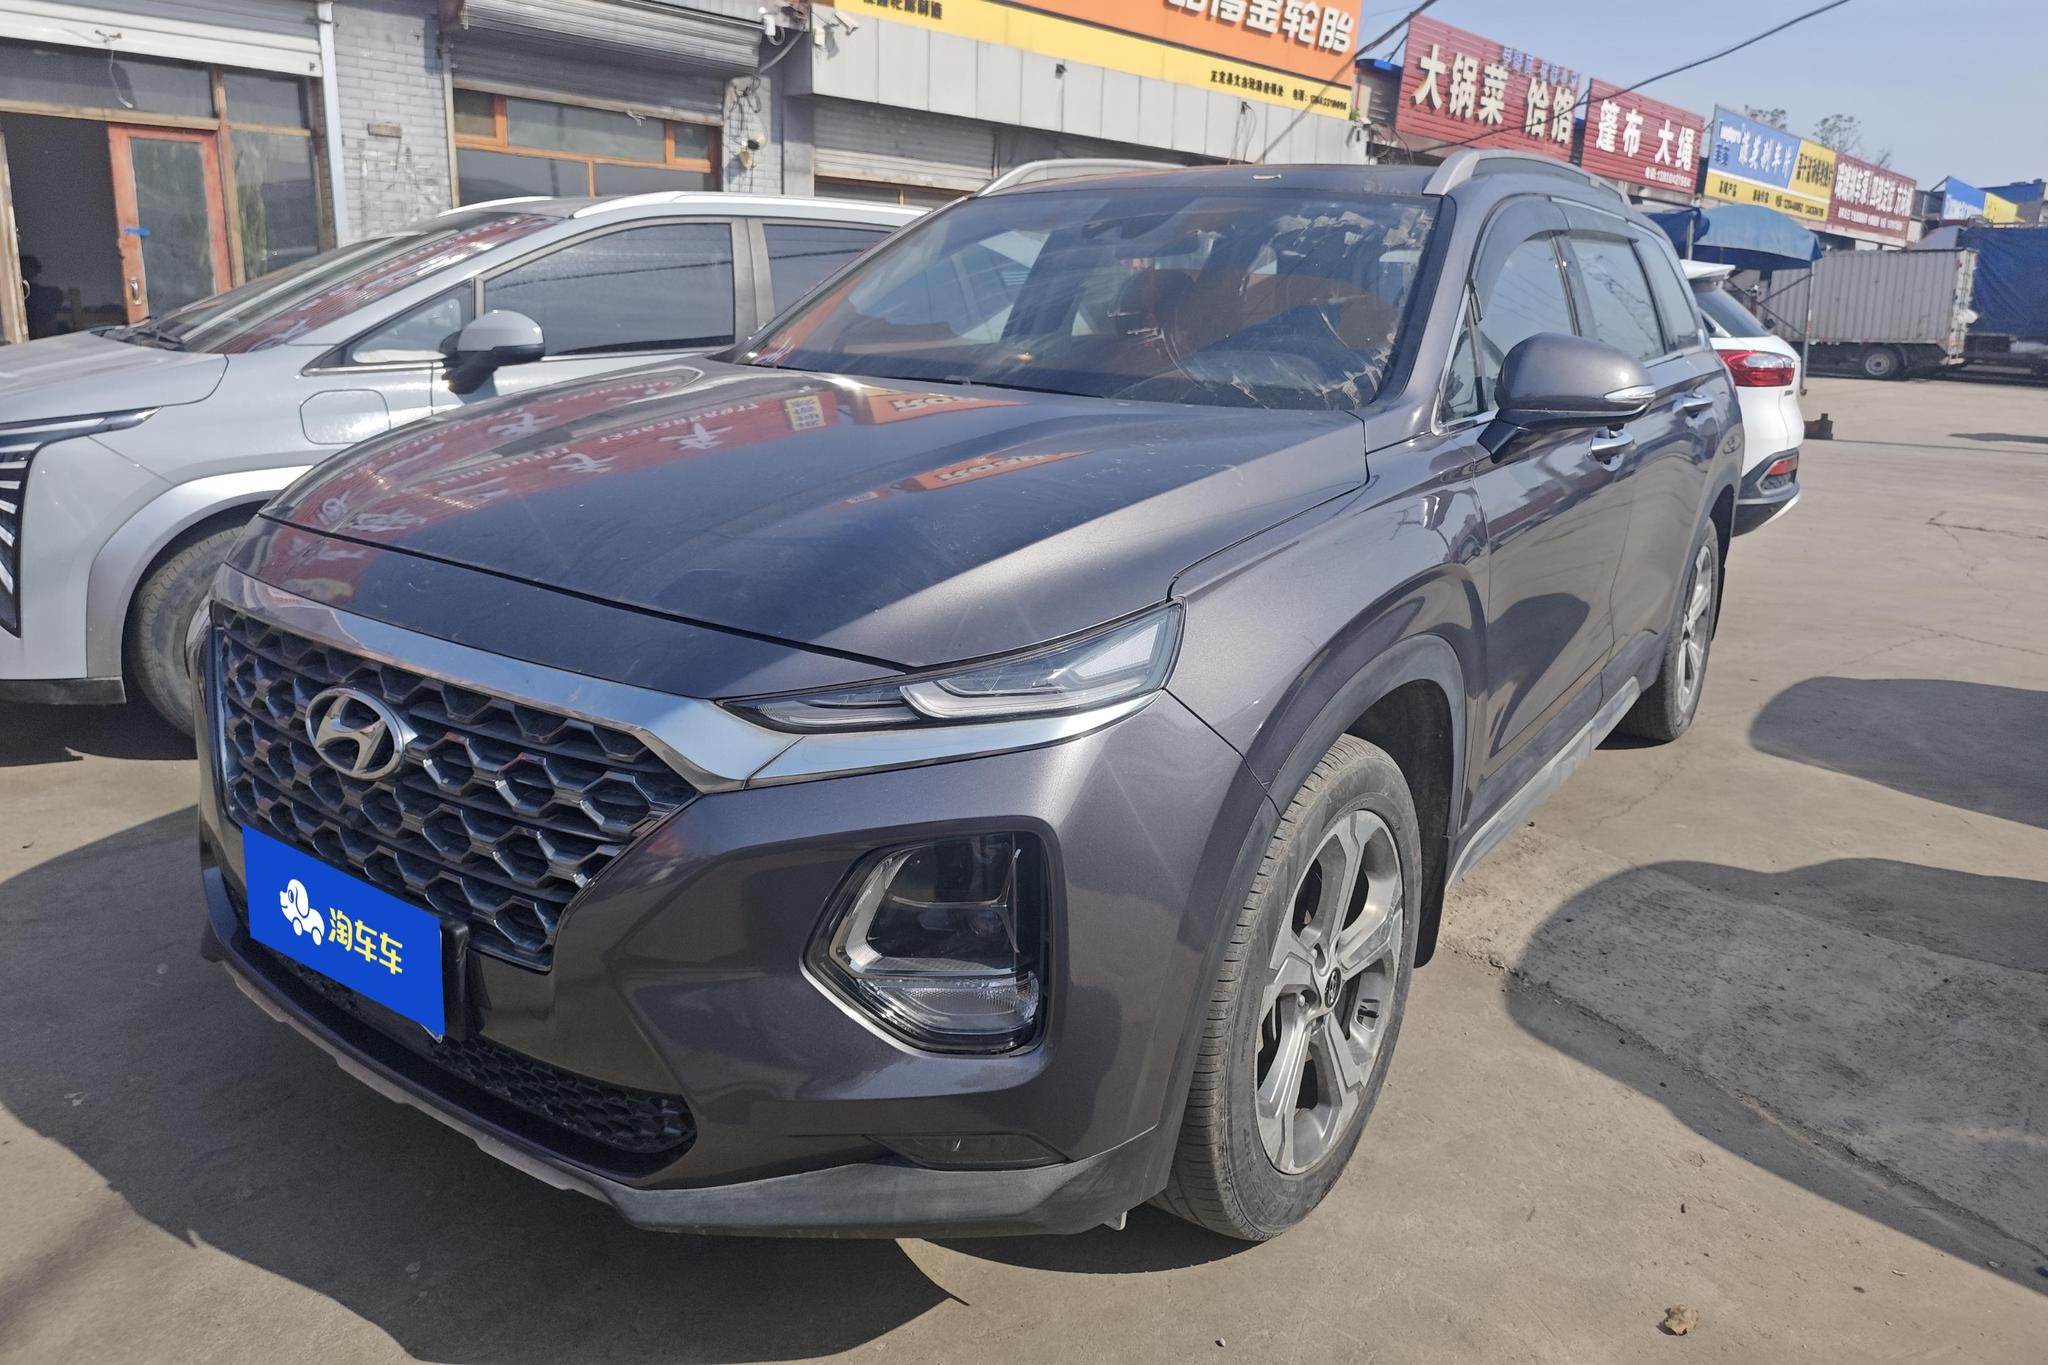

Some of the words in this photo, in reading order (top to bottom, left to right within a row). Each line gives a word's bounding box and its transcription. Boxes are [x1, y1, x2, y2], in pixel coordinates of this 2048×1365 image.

[1411, 43, 1509, 125] 大锅菜
[1595, 98, 1644, 158] 篷布
[1654, 119, 1695, 172] 大绳
